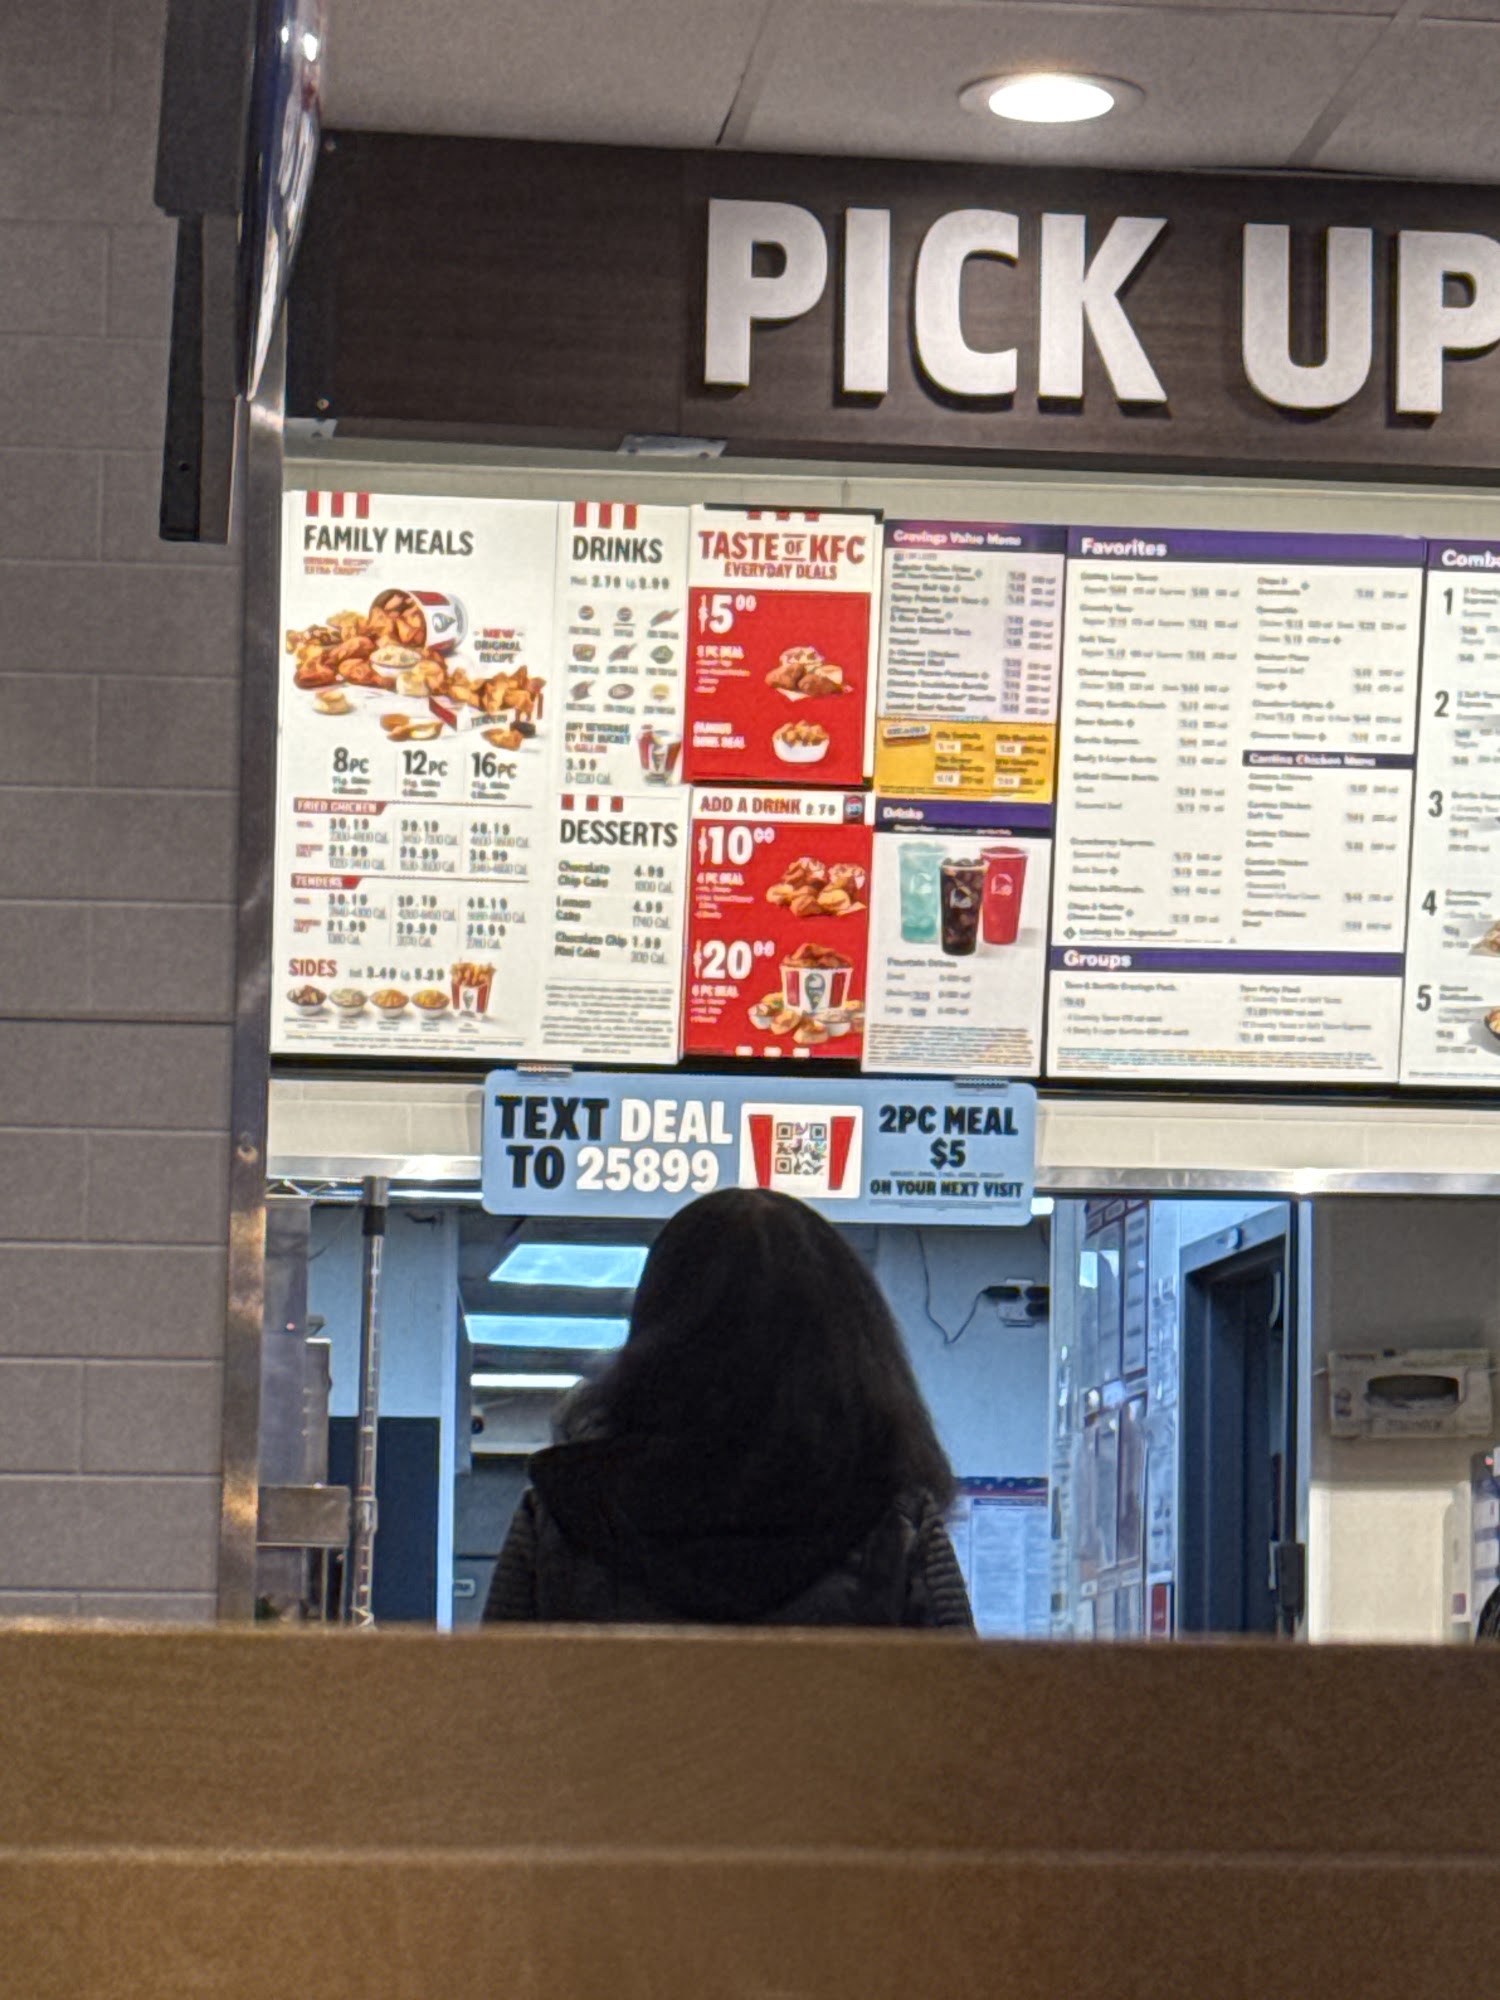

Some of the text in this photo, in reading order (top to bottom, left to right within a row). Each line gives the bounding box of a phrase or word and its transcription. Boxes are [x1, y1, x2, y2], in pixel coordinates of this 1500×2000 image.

[704, 198, 1500, 413] PICK UP
[303, 525, 474, 556] FAMILY MEALS
[572, 535, 663, 564] DRINKS
[698, 531, 866, 564] TASTE OF KFC
[893, 529, 948, 545] Cravings
[951, 531, 984, 545] Value
[1081, 537, 1168, 557] Favorites
[724, 562, 837, 580] EVERYDAY DEALS
[1443, 588, 1453, 615] 1
[1434, 690, 1449, 717] 2
[700, 796, 733, 812] ADD
[736, 797, 748, 813] A
[752, 798, 801, 815] DRINK
[1428, 790, 1443, 818] 3
[560, 819, 678, 848] DESSERTS
[1422, 890, 1437, 917] 4
[288, 958, 338, 977] SIDES
[1063, 950, 1132, 969] Groups
[1416, 984, 1432, 1012] 5
[495, 1095, 733, 1144] TEXT DEAL
[879, 1104, 1019, 1136] 2PC MEAL
[930, 1137, 966, 1170] $5
[506, 1145, 719, 1193] TO 25899
[870, 1179, 1024, 1199] ON YOUR NEXT VISIT
